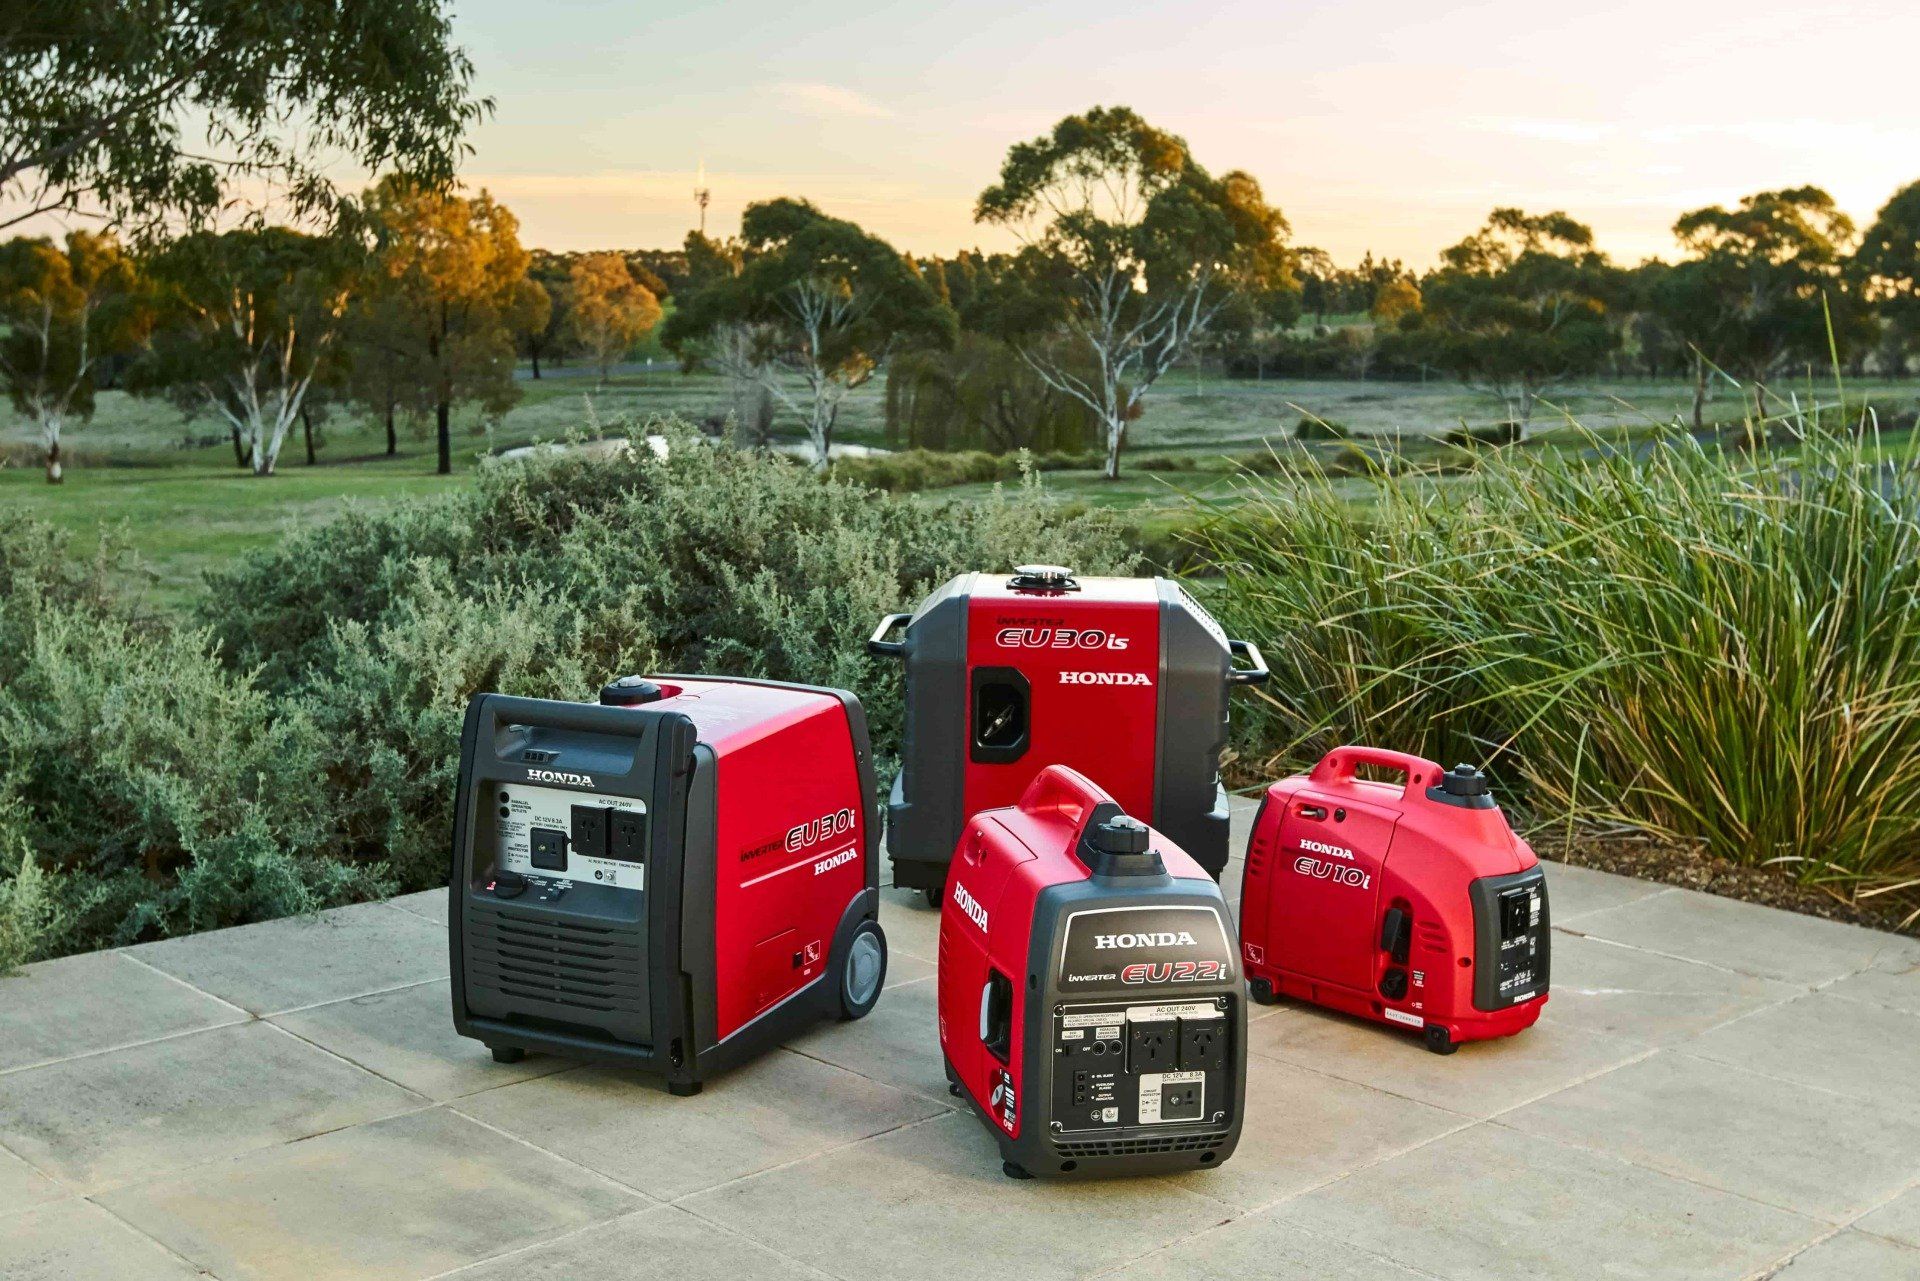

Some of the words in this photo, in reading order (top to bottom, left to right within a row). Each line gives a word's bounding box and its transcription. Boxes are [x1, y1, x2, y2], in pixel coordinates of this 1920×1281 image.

[1059, 671, 1152, 686] HONDA
[527, 768, 594, 787] HONDA
[785, 808, 855, 853] EU30i
[1300, 838, 1355, 860] HONDA
[815, 848, 857, 876] HONDA
[1293, 857, 1371, 890] EU10i
[954, 881, 989, 933] HONDA
[1094, 931, 1198, 949] HONDA
[1121, 960, 1227, 985] EU22i
